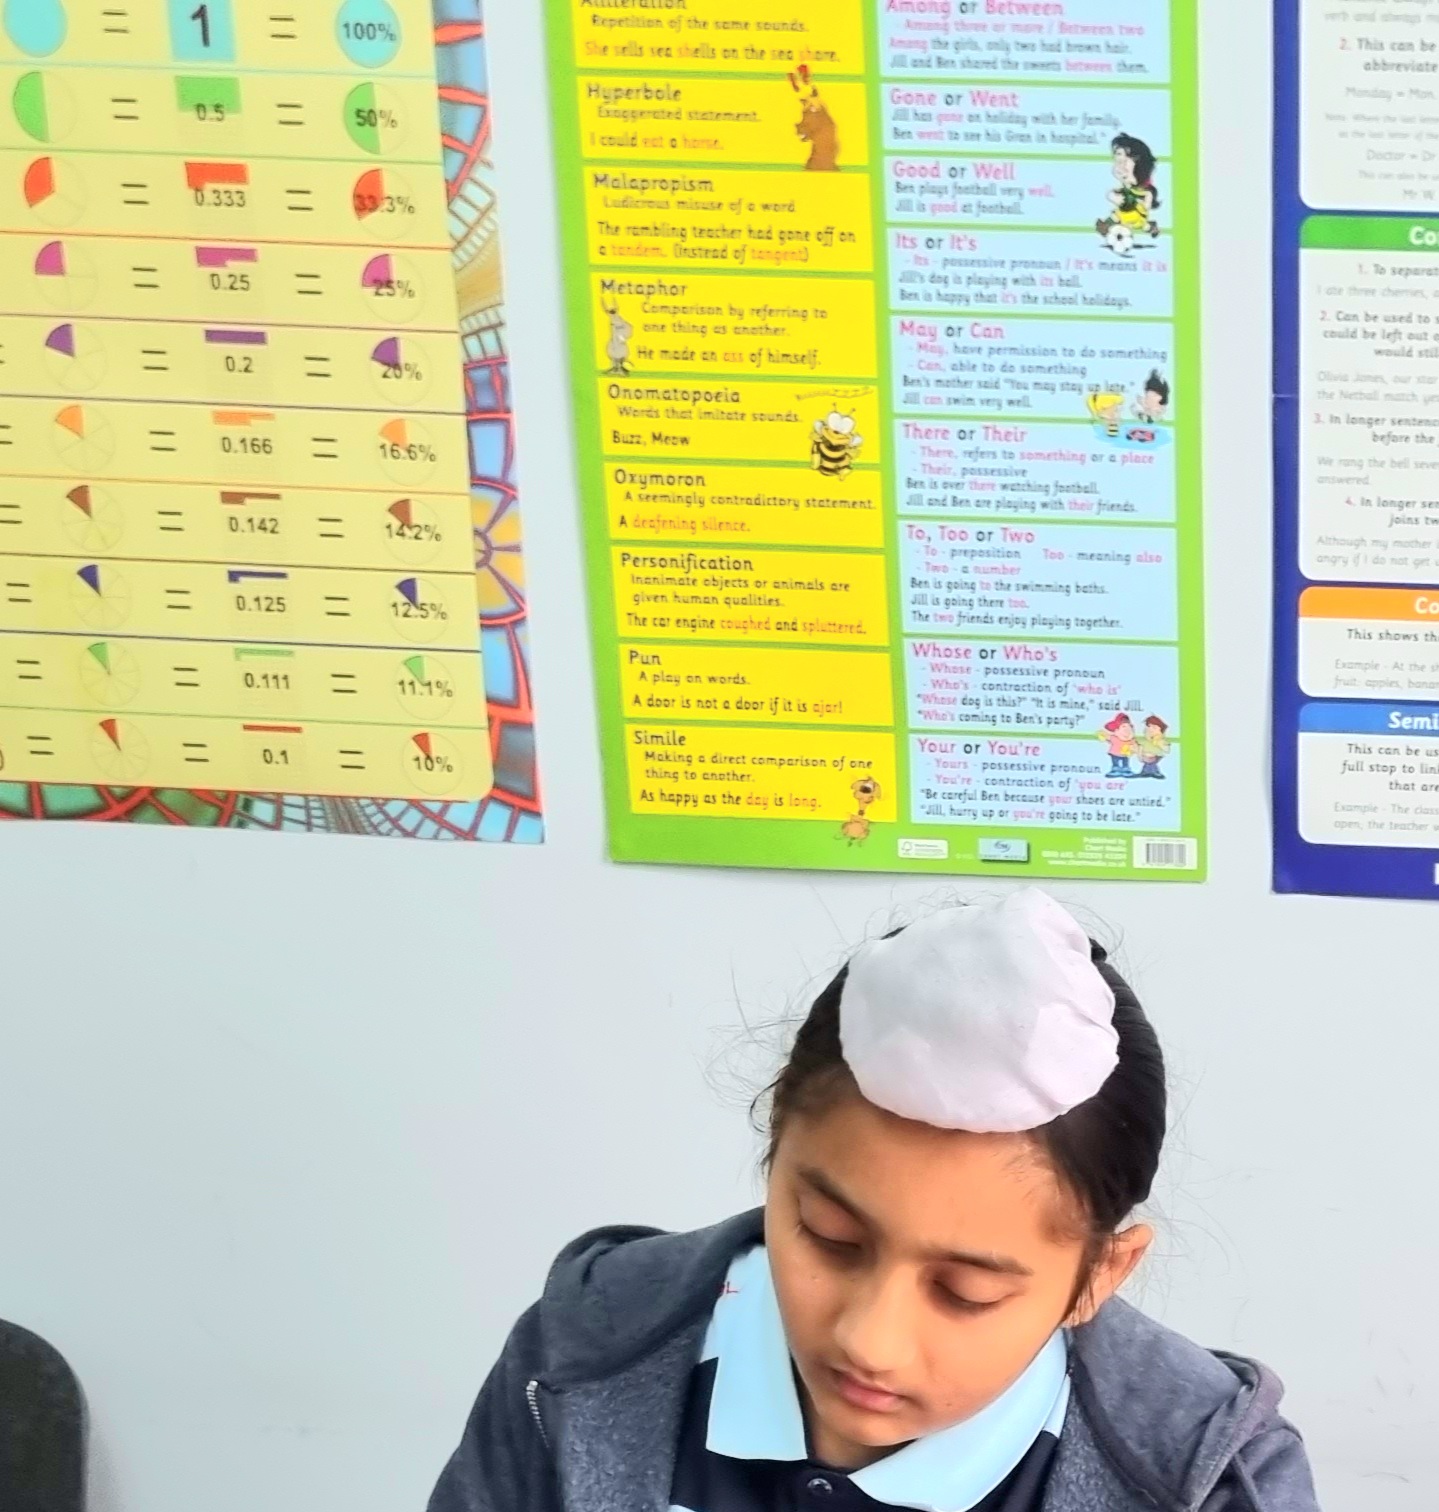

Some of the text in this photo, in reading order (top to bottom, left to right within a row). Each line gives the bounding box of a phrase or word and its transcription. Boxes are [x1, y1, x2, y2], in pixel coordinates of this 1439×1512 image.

[960, 0, 977, 14] or
[190, 4, 211, 47] 1
[343, 22, 396, 42] 100%
[587, 84, 682, 104] Hyperbole
[890, 89, 1019, 108] Gone or Went
[196, 104, 225, 122] 0.5
[354, 109, 398, 129] 50%
[893, 162, 1015, 179] Good or Well
[594, 173, 714, 193] Malapropism
[194, 190, 246, 208] 0.333
[354, 196, 415, 214] 33.3%
[895, 234, 978, 250] Its or It's
[1373, 265, 1385, 275] To
[210, 274, 250, 291] 0.25
[374, 280, 416, 298] 25%
[601, 279, 687, 299] Metaphor
[900, 322, 1004, 341] May or Can
[225, 357, 254, 373] 0.2
[382, 364, 423, 382] 20%
[609, 384, 740, 406] Onomatopoeia
[612, 431, 690, 446] Buzz, Meow
[903, 424, 1027, 442] There or Their
[221, 437, 273, 454] 0.166
[379, 444, 437, 462] 16.6%
[615, 469, 705, 488] Oxymoron
[229, 517, 279, 534] 0.142
[385, 523, 442, 542] 14.2%
[906, 525, 1035, 543] To, Too or Two
[621, 553, 753, 572] Personification
[235, 596, 286, 613] 0.125
[390, 602, 448, 620] 12.5%
[1347, 629, 1373, 640] This
[1379, 631, 1418, 642] shows
[629, 651, 661, 665] Pun
[912, 643, 1057, 661] Whose or Who's
[244, 673, 290, 690] 0.111
[398, 679, 453, 698] 11.1%
[632, 695, 842, 717] A door is not a door if it is ajar!
[633, 731, 686, 746] Simile
[919, 739, 1040, 756] Your or You're
[262, 749, 289, 764] 0.1
[1347, 744, 1373, 756] This
[1378, 746, 1400, 756] can
[1406, 746, 1420, 757] be
[413, 755, 453, 773] 10%
[1341, 761, 1364, 774] full
[1369, 763, 1396, 777] stop
[1402, 764, 1415, 774] to
[1389, 782, 1415, 792] that
[640, 790, 821, 811] As happy as the day is long.
